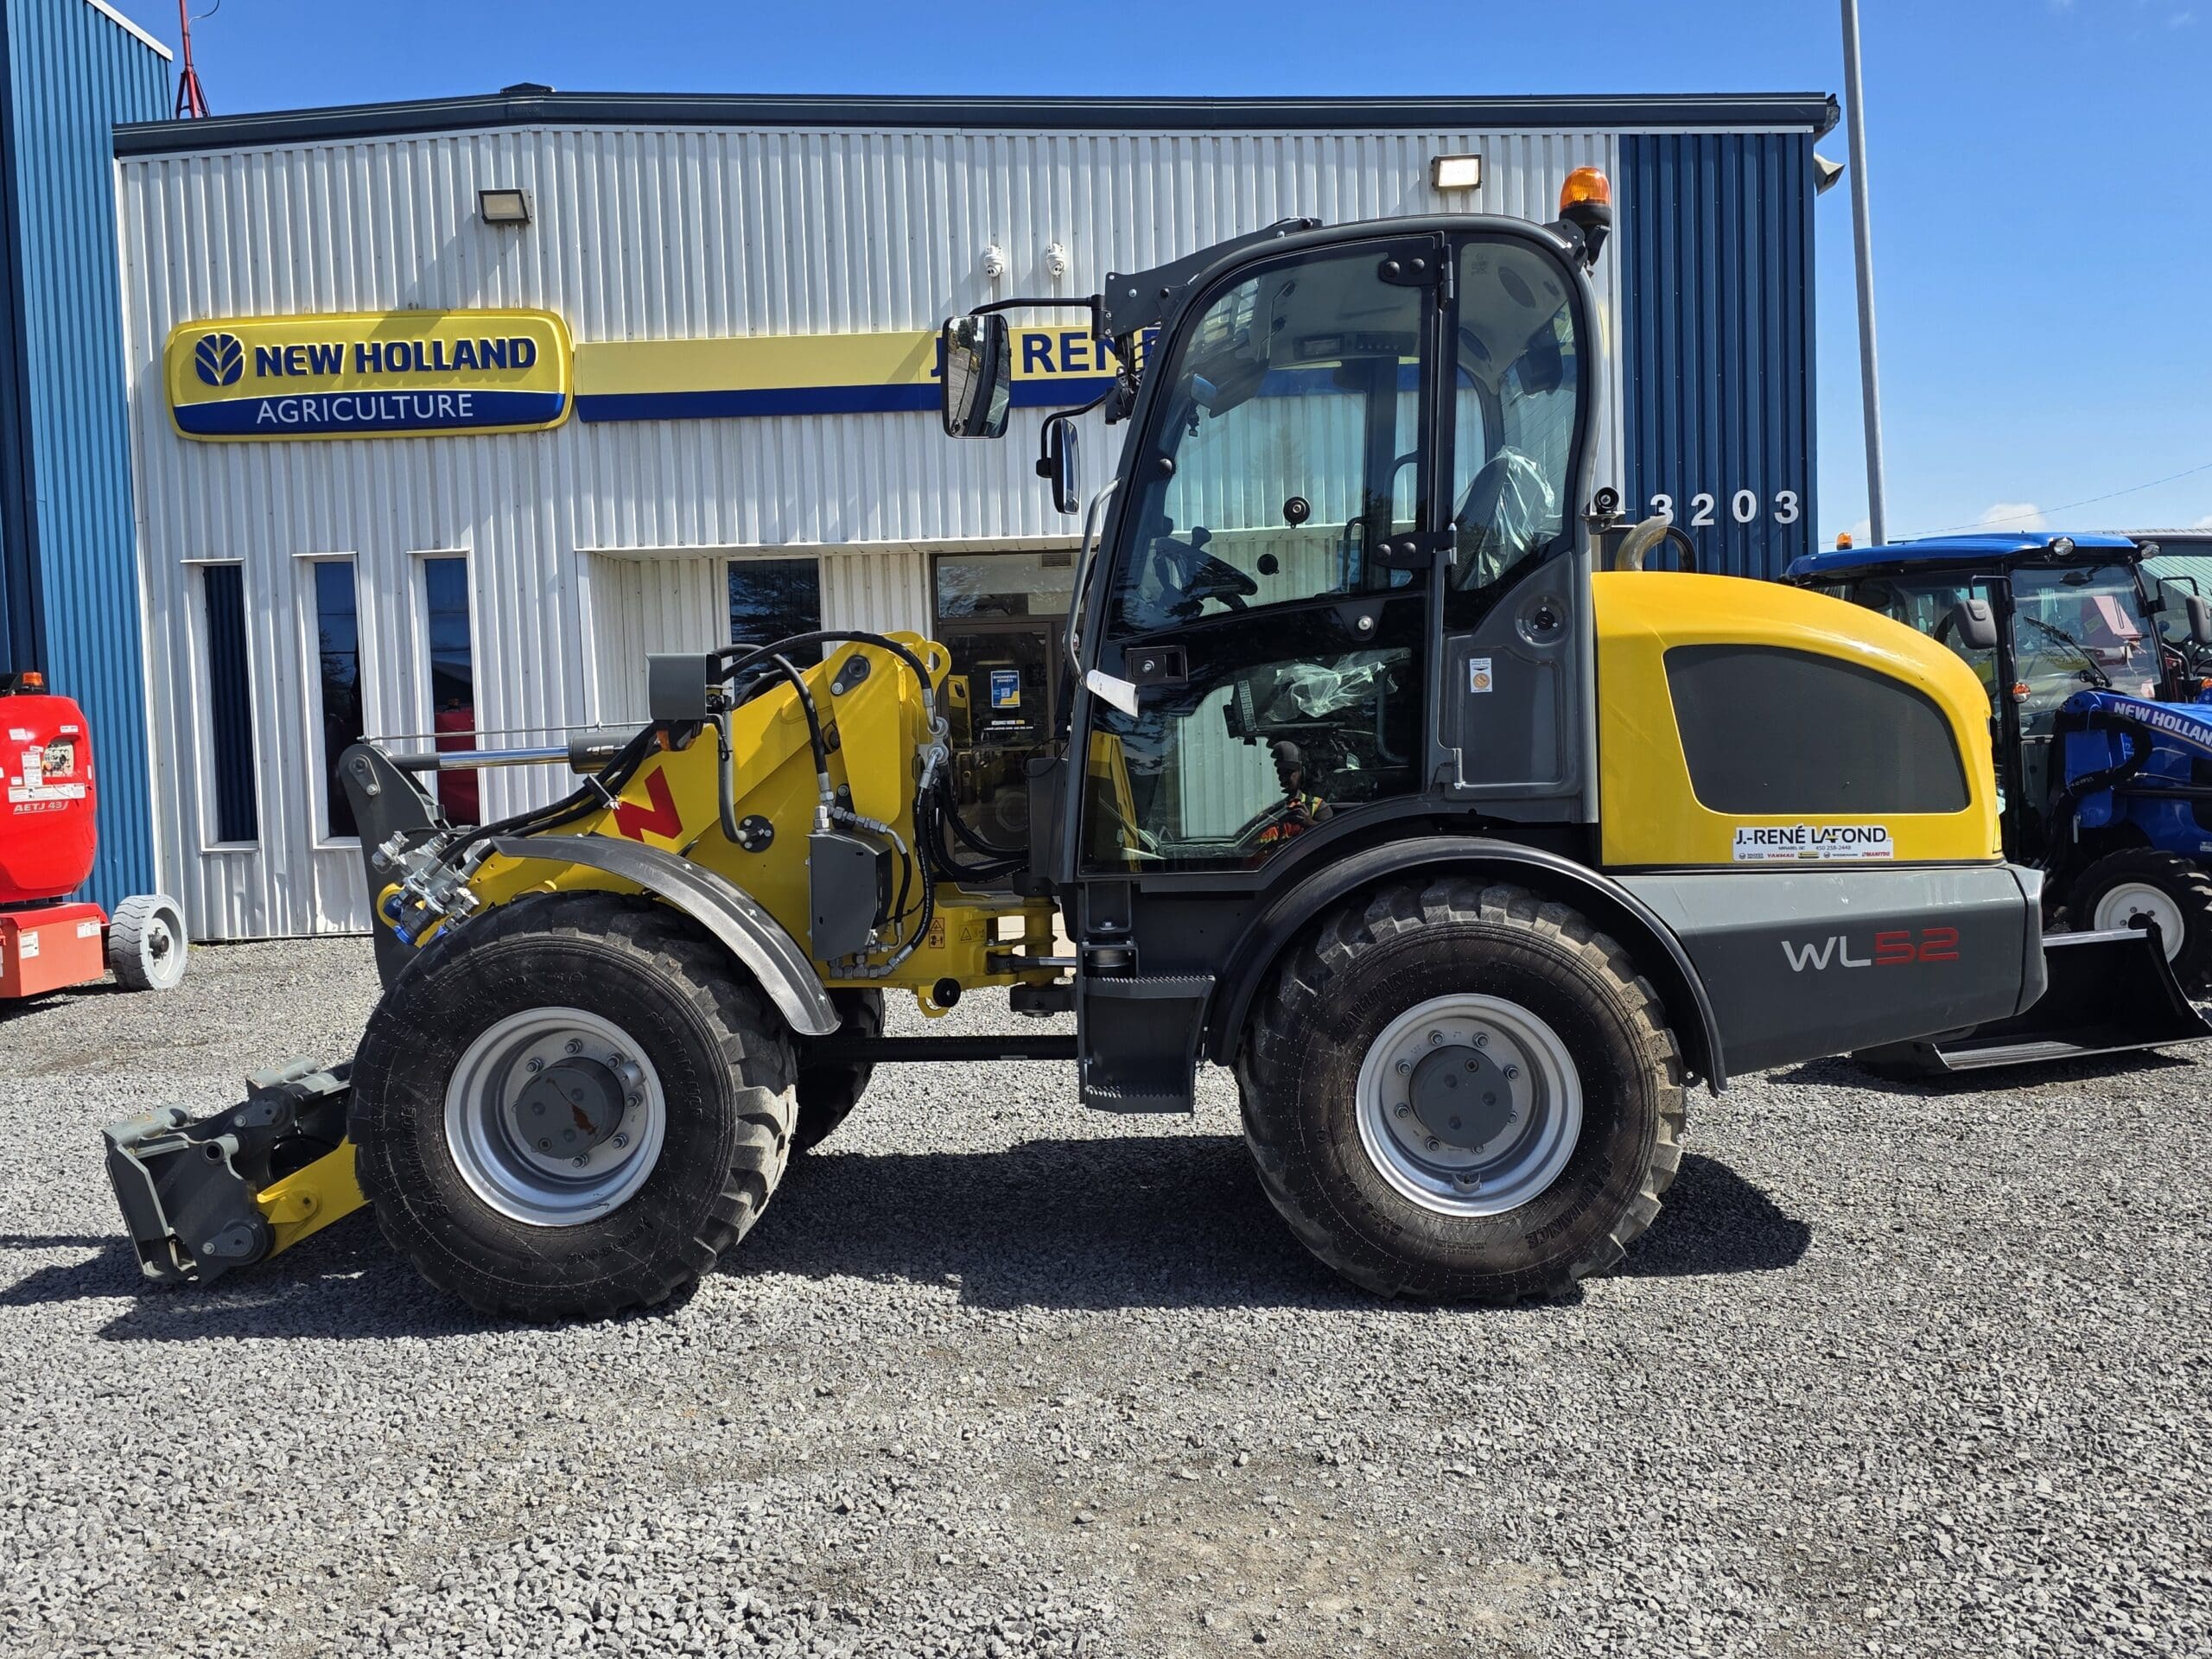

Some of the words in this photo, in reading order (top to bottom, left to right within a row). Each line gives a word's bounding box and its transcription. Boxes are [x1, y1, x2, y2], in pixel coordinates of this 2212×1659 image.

[256, 343, 346, 378] NEW
[355, 337, 537, 374] HOLLAND
[257, 393, 474, 424] AGRICULTURE
[2114, 702, 2151, 722] NEW
[2152, 710, 2212, 747] HOLLAN
[13, 803, 46, 812] AETJ
[48, 801, 62, 810] 43
[1736, 825, 1806, 845] J.-RENÉ
[1811, 827, 1886, 843] LAFOND
[1781, 926, 1960, 972] WL52
